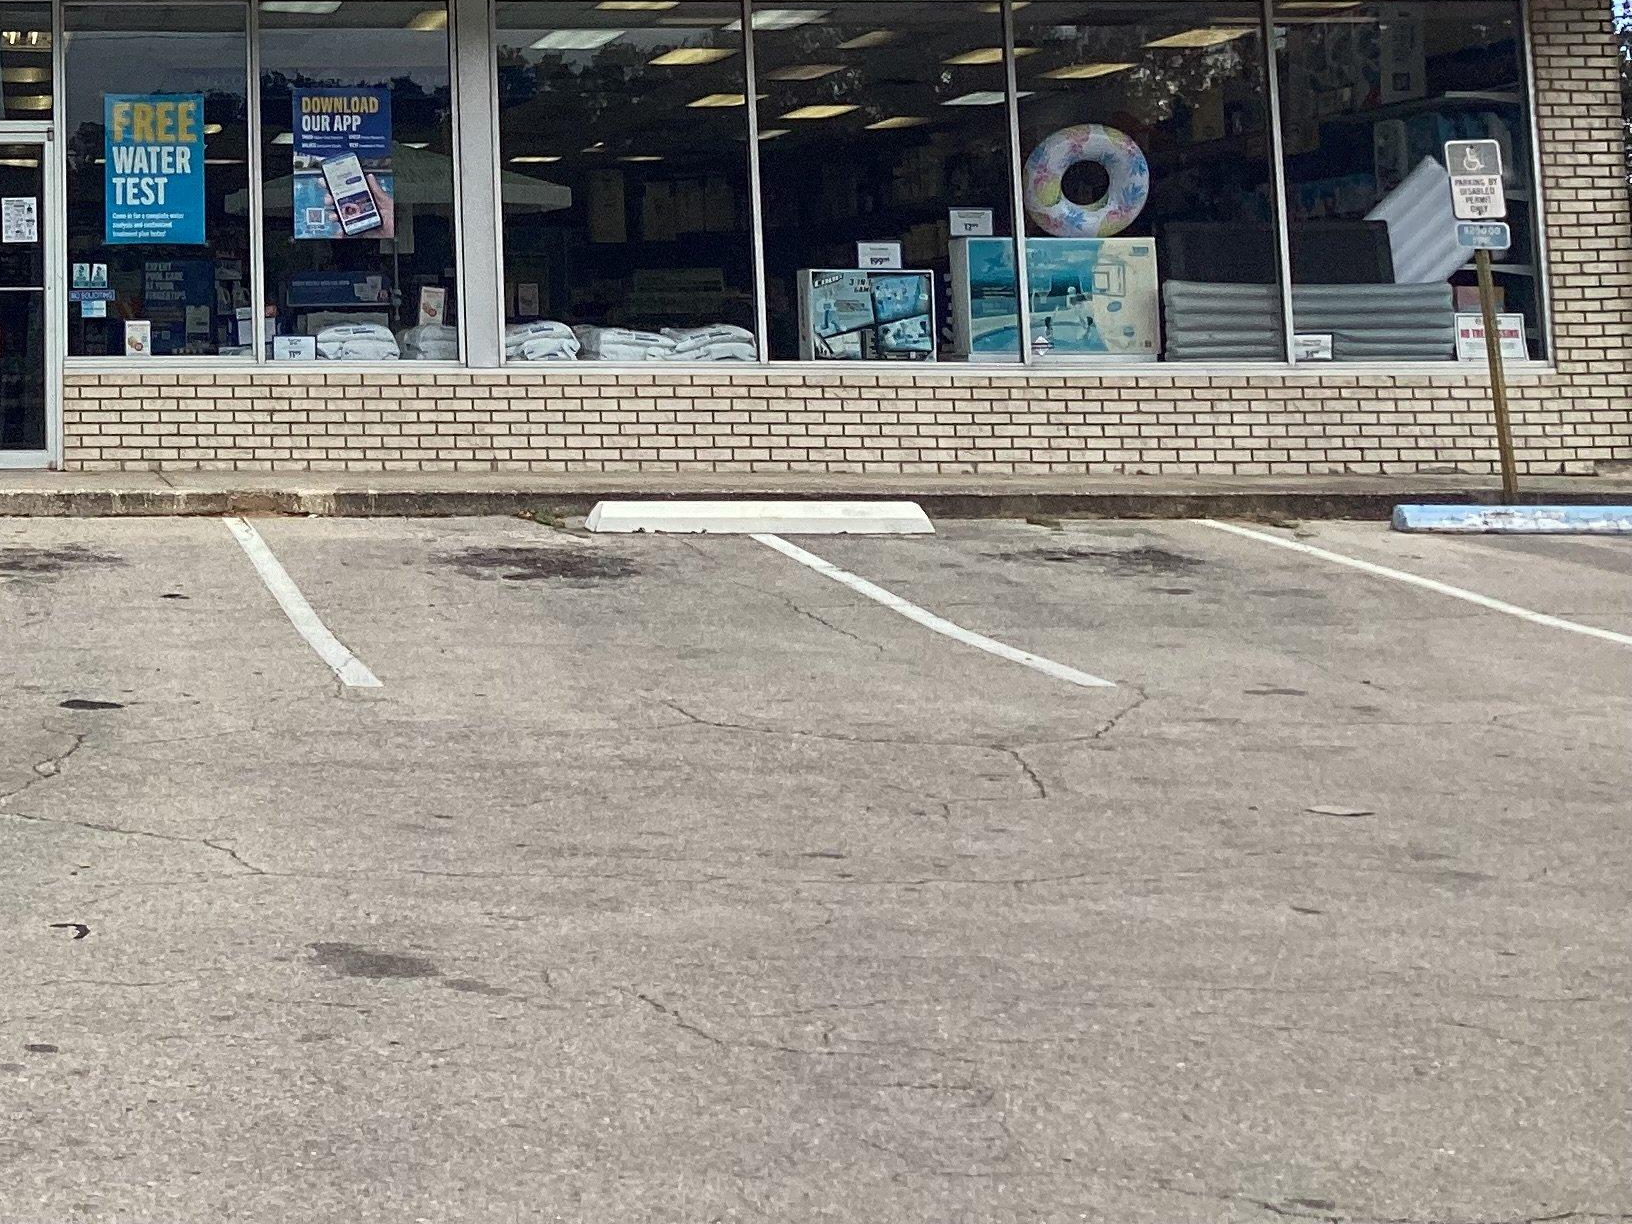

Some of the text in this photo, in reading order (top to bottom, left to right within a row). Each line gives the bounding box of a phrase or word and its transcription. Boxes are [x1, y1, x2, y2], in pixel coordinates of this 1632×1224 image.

[301, 97, 379, 113] DOWNLOAD
[112, 102, 197, 144] FREE
[302, 115, 362, 132] OUR APP
[112, 146, 191, 174] WATER
[112, 177, 168, 205] TEST
